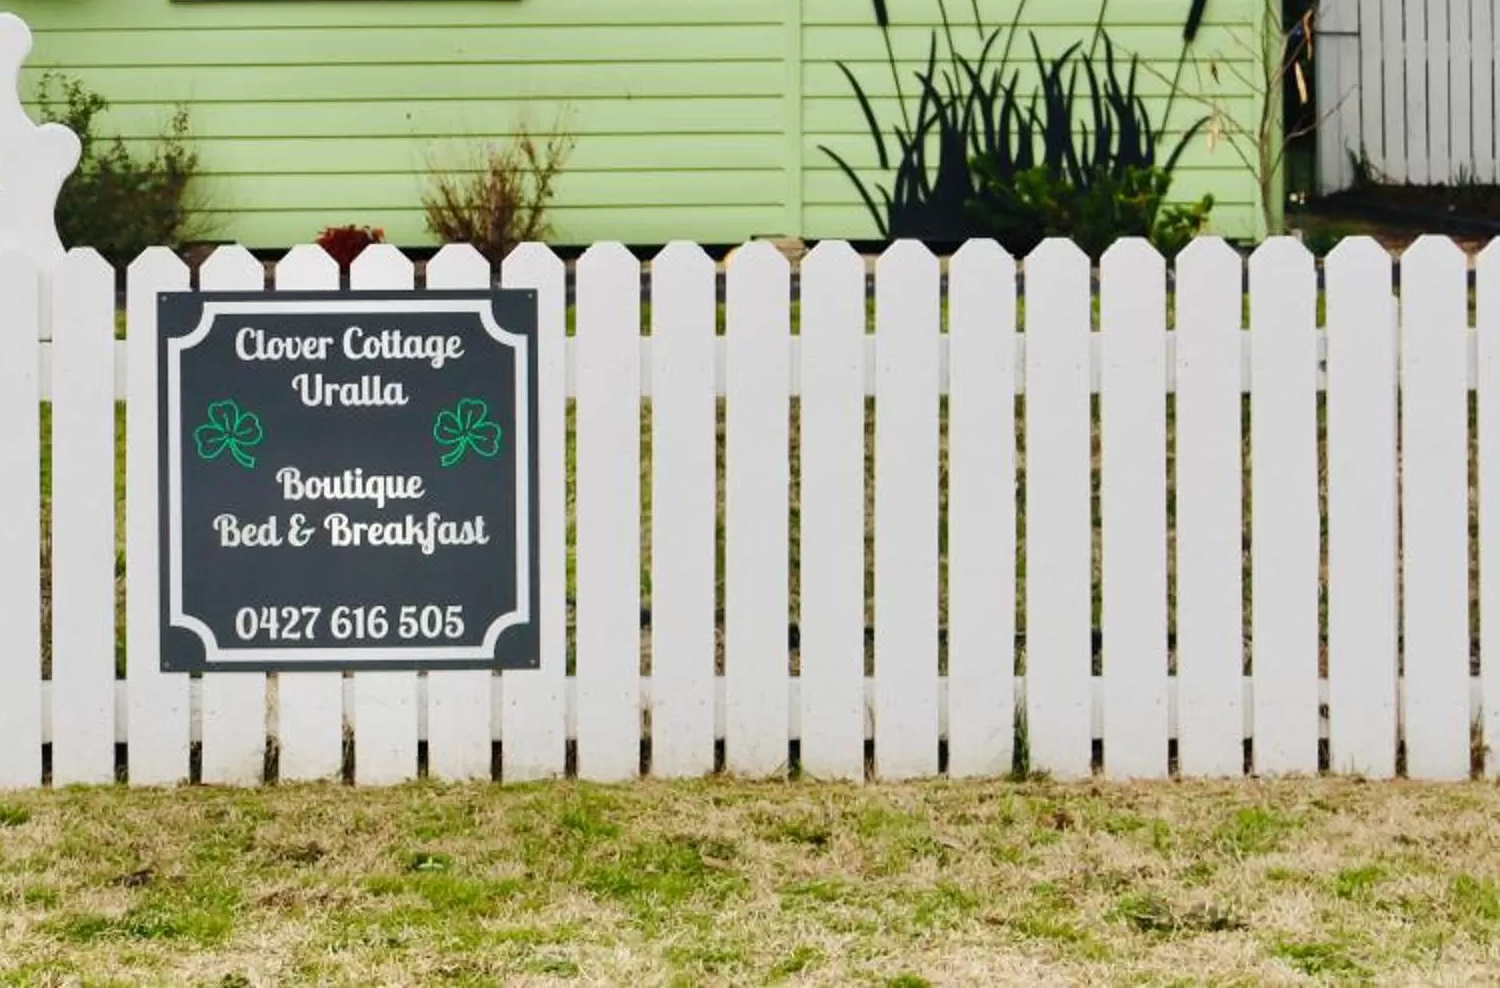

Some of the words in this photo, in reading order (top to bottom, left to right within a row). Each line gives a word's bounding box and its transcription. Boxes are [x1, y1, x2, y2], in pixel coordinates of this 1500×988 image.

[236, 328, 334, 360] Clover
[343, 327, 464, 368] Cottage
[292, 374, 408, 406] Uralla
[276, 467, 425, 508] Boutique
[213, 514, 283, 547] Bed
[288, 513, 315, 546] &
[324, 512, 489, 555] Breakfast
[236, 606, 321, 640] 0427
[331, 606, 388, 639] 616
[399, 605, 464, 638] 505
